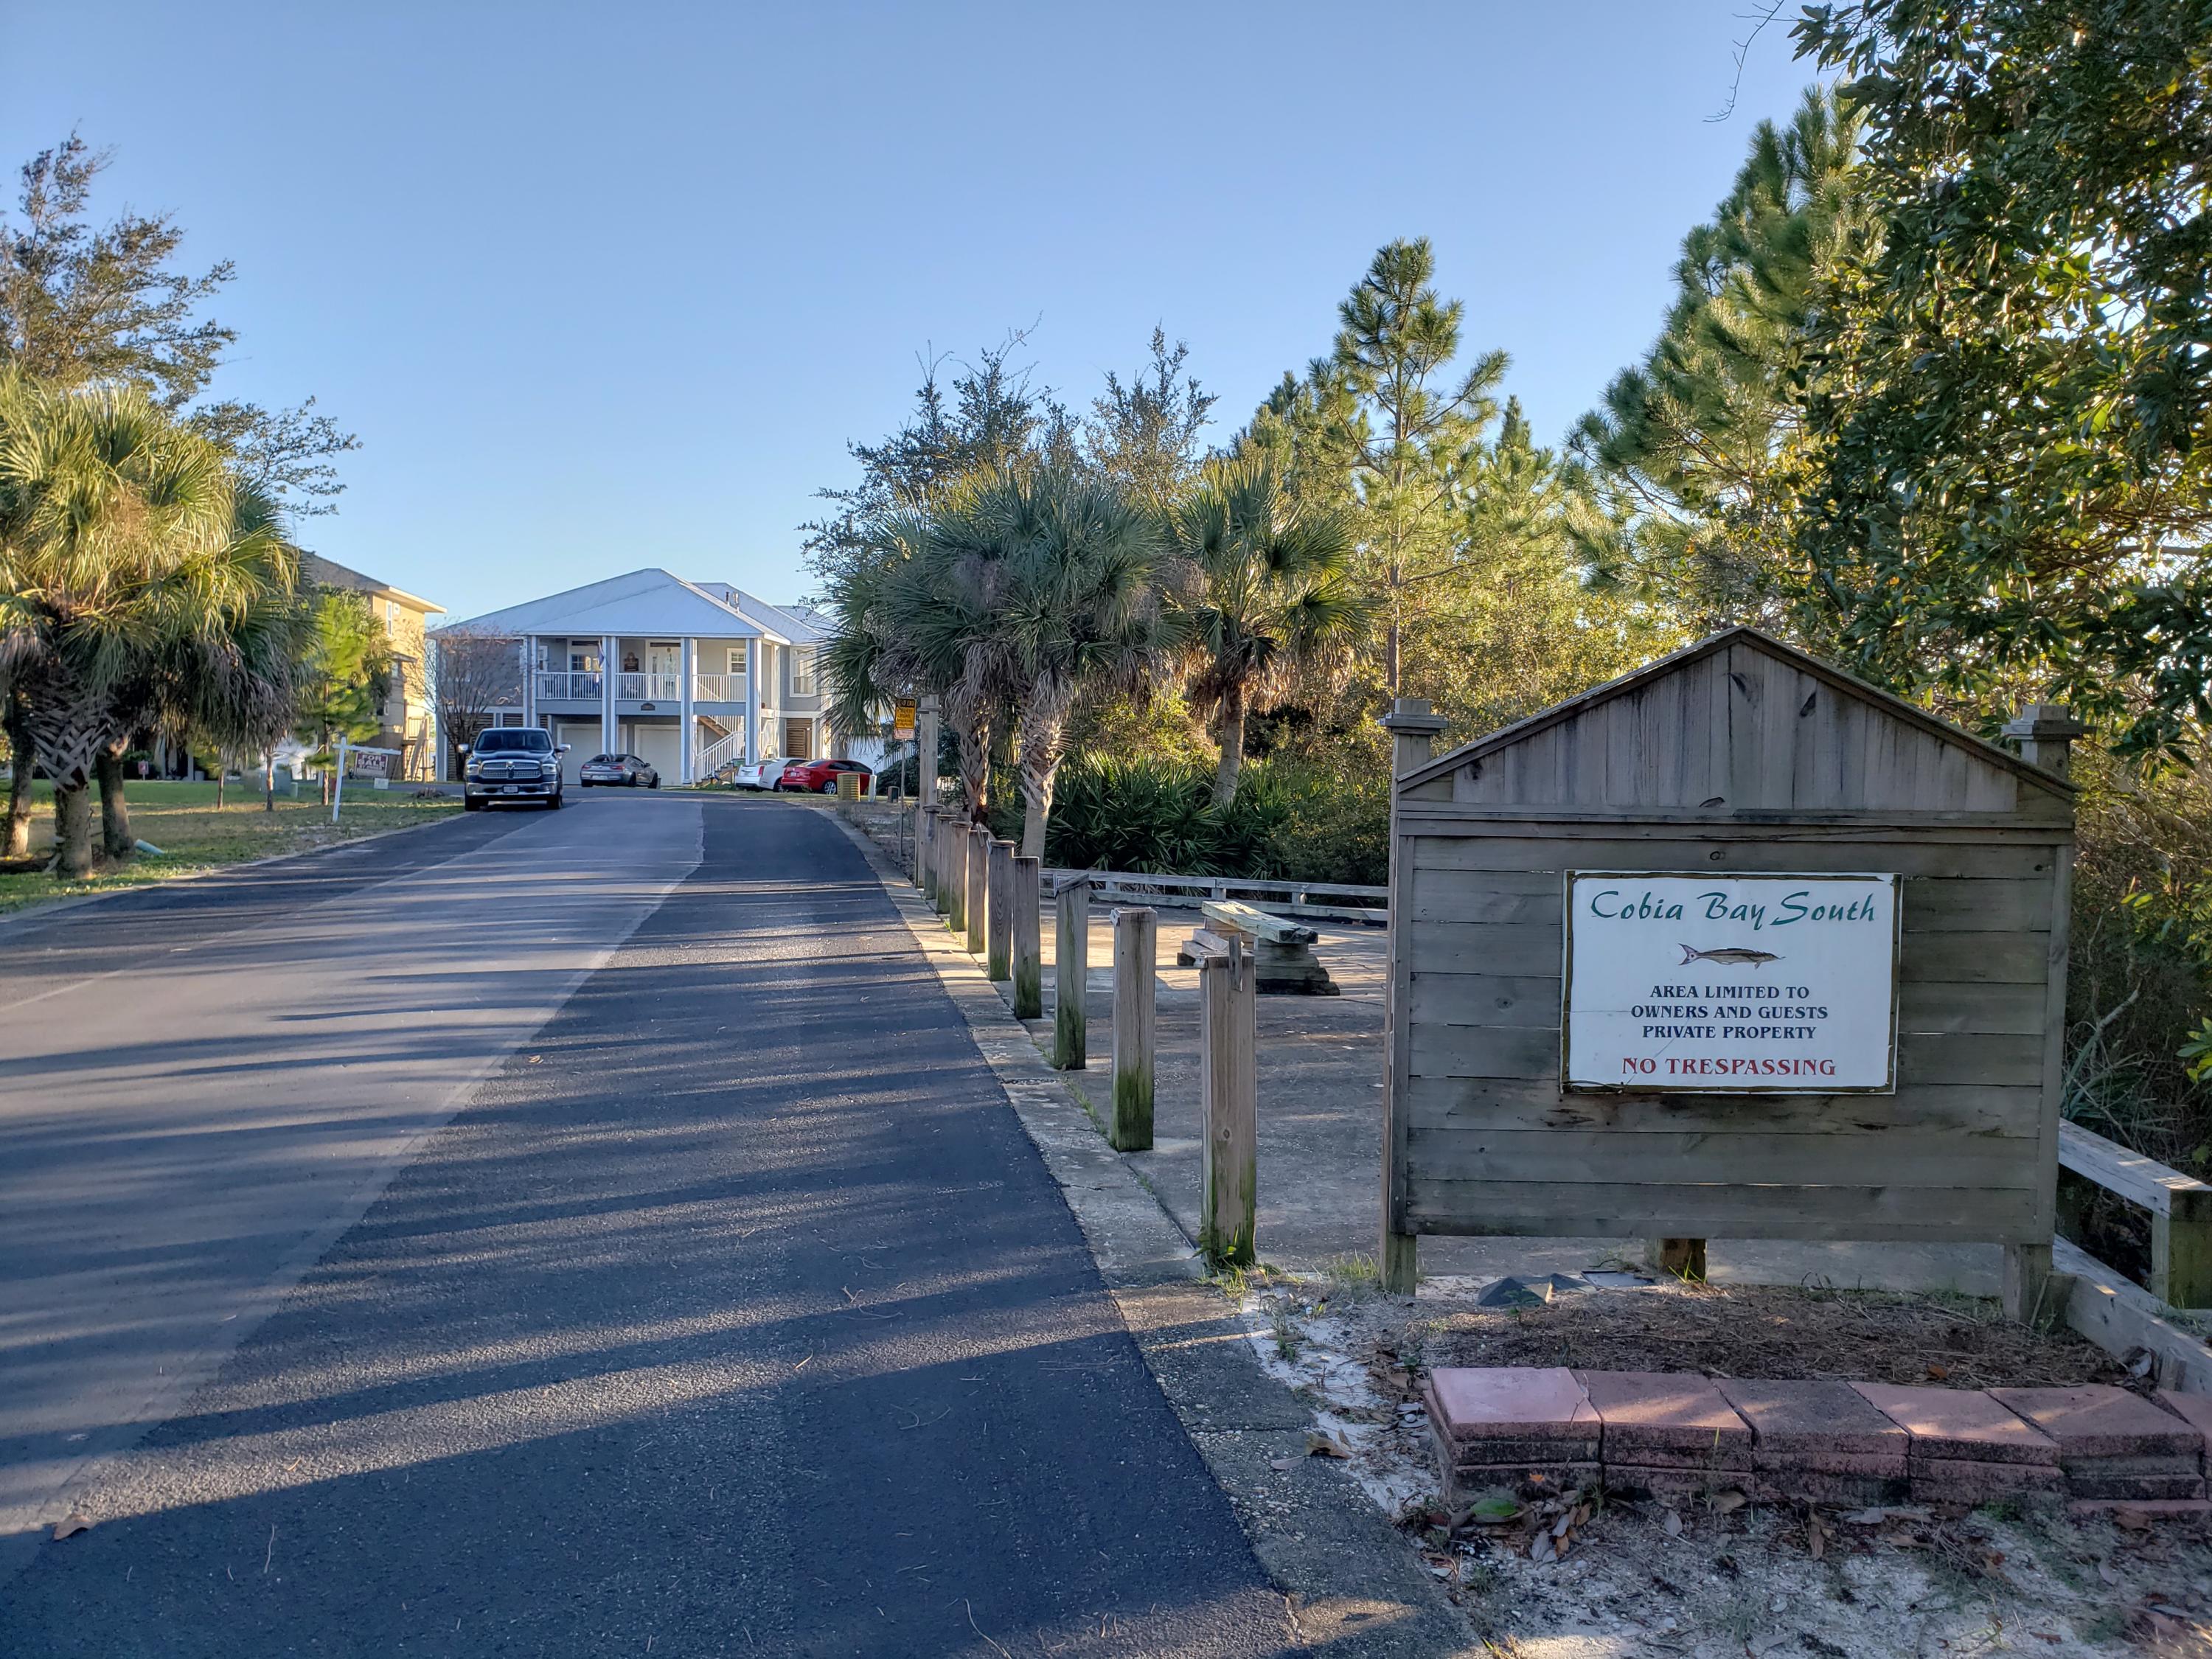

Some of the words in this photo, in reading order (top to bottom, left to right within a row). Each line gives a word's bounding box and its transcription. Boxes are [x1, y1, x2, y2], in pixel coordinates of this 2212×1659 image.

[358, 759, 385, 768] SALE
[1590, 891, 1683, 920] Cobia
[1697, 891, 1765, 931] Bay
[1770, 891, 1874, 926] South
[1649, 985, 1700, 998] AREA
[1704, 986, 1780, 999] LIMITED
[1785, 986, 1809, 999] TO
[1630, 1005, 1708, 1018] OWNERS
[1714, 1006, 1752, 1019] AND
[1758, 1006, 1829, 1019] GUESTS
[1642, 1025, 1717, 1038] PRIVATE
[1722, 1026, 1817, 1039] PROPERTY
[1622, 1057, 1657, 1074] NO
[1664, 1058, 1836, 1076] TRESPASSING
